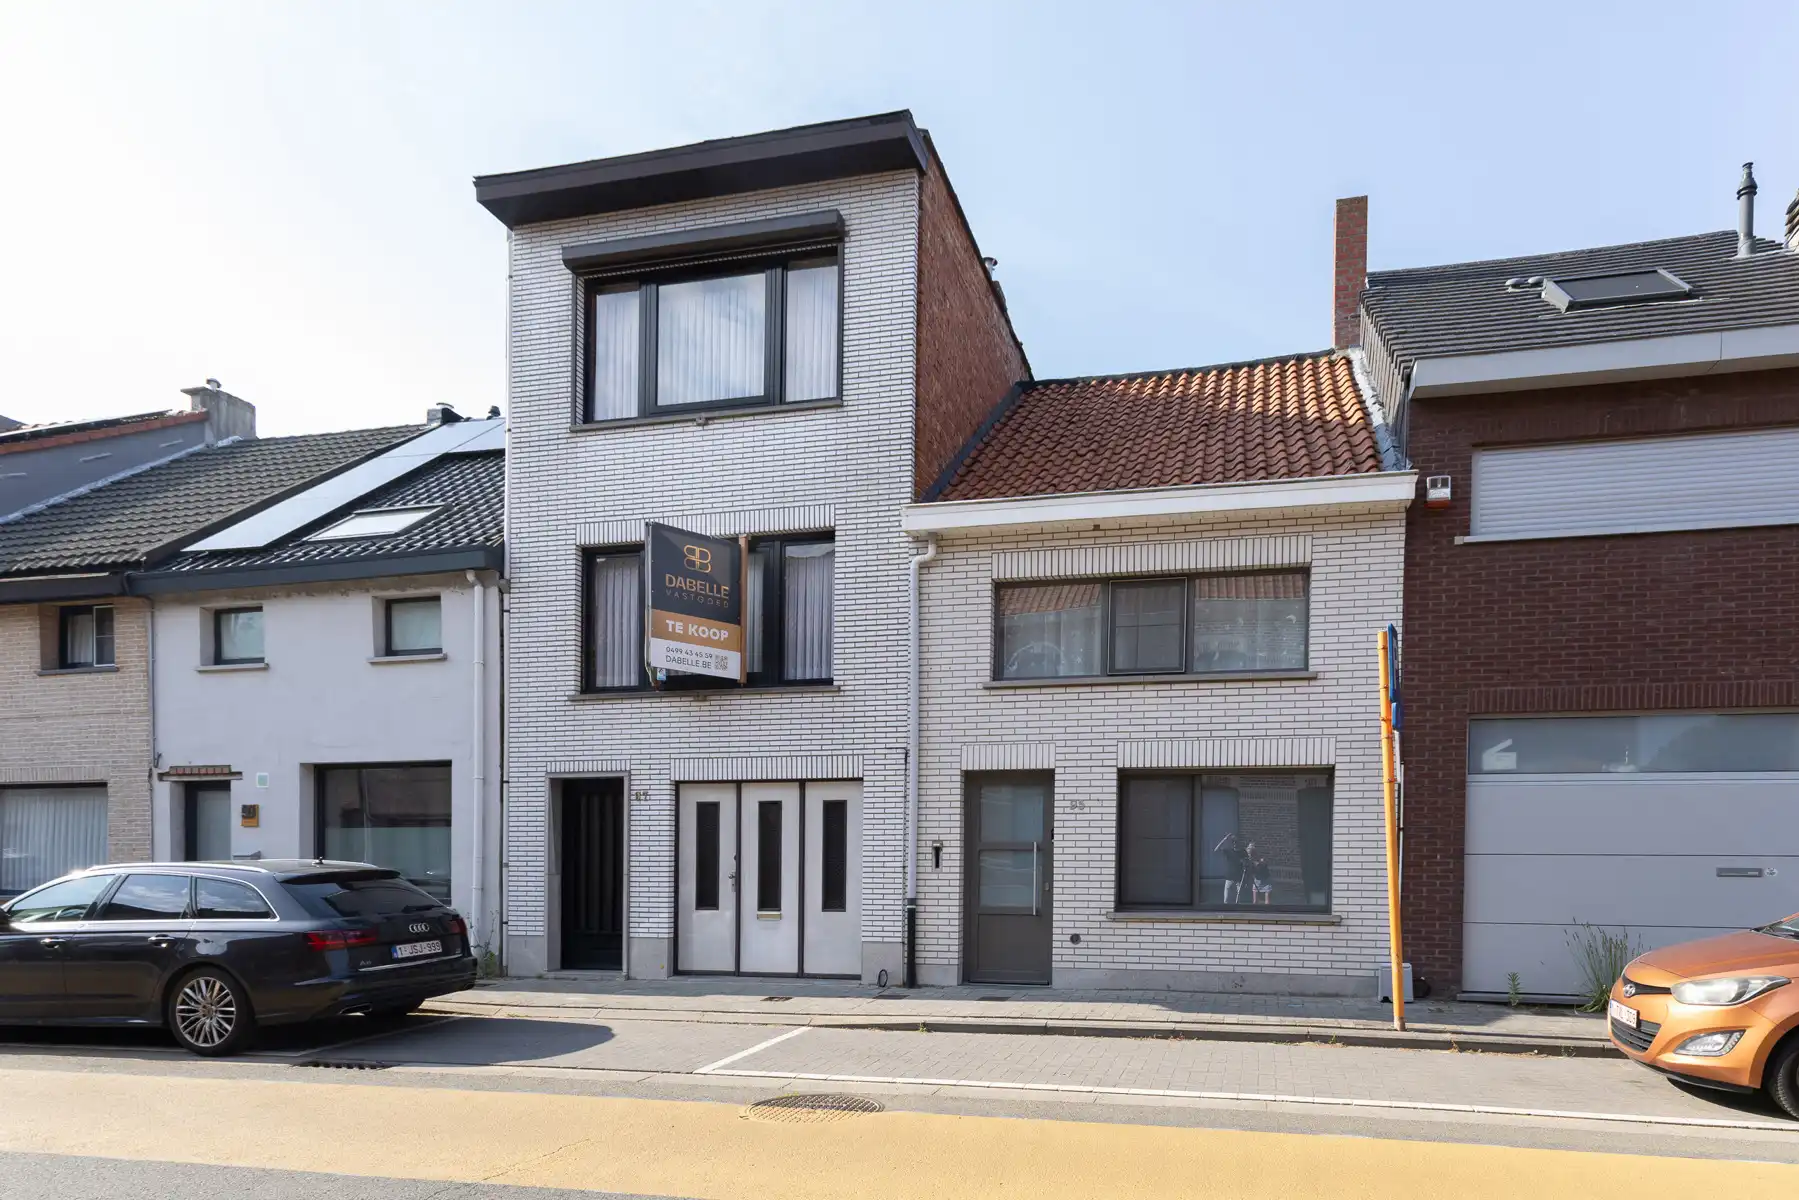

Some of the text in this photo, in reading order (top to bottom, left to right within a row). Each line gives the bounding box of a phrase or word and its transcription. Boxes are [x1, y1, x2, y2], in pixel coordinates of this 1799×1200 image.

[665, 573, 730, 599] DABELLE
[665, 590, 729, 608] VASTGOED
[666, 619, 729, 641] TE KOOP
[665, 646, 683, 655] 0499
[665, 655, 712, 669] DABELLE.BE
